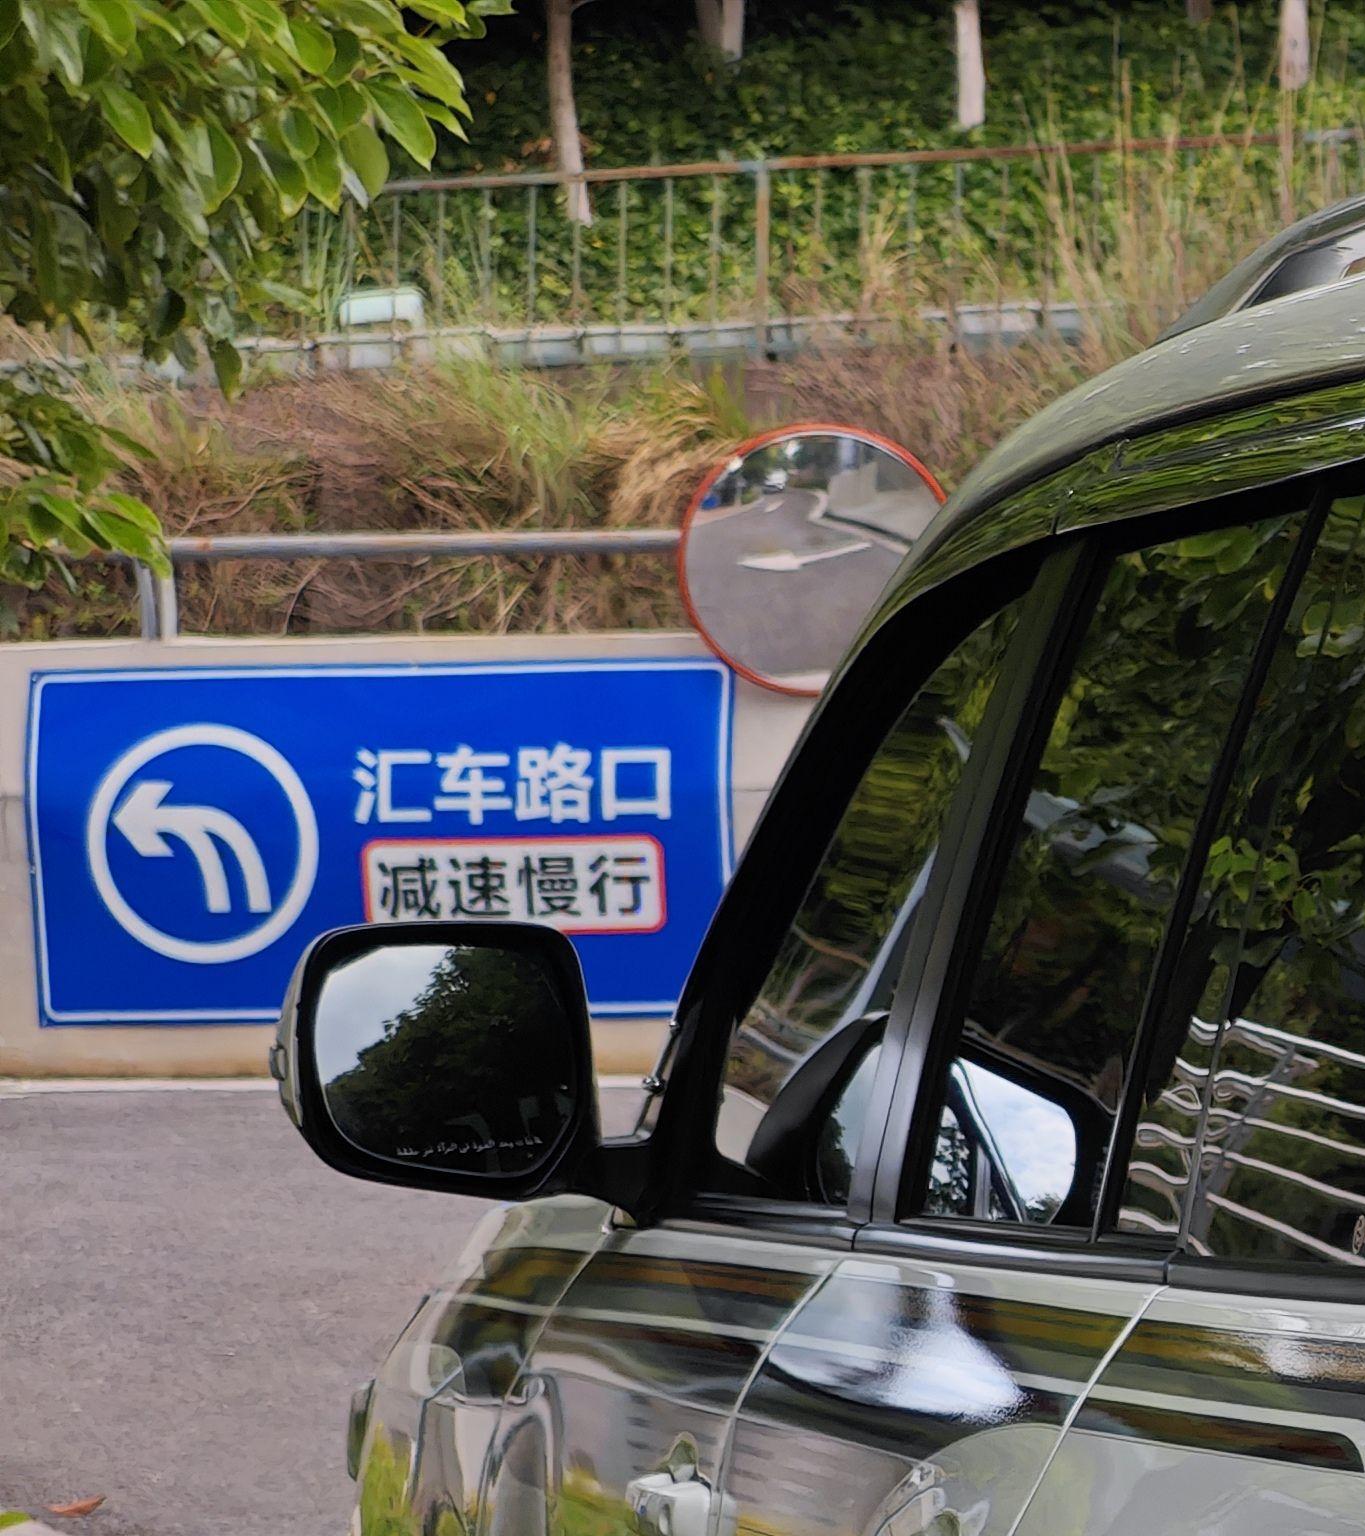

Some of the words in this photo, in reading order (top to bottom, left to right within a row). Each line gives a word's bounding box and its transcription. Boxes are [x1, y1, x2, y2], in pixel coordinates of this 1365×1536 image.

[352, 741, 672, 825] 汇车路口
[378, 854, 650, 918] 减速慢行
